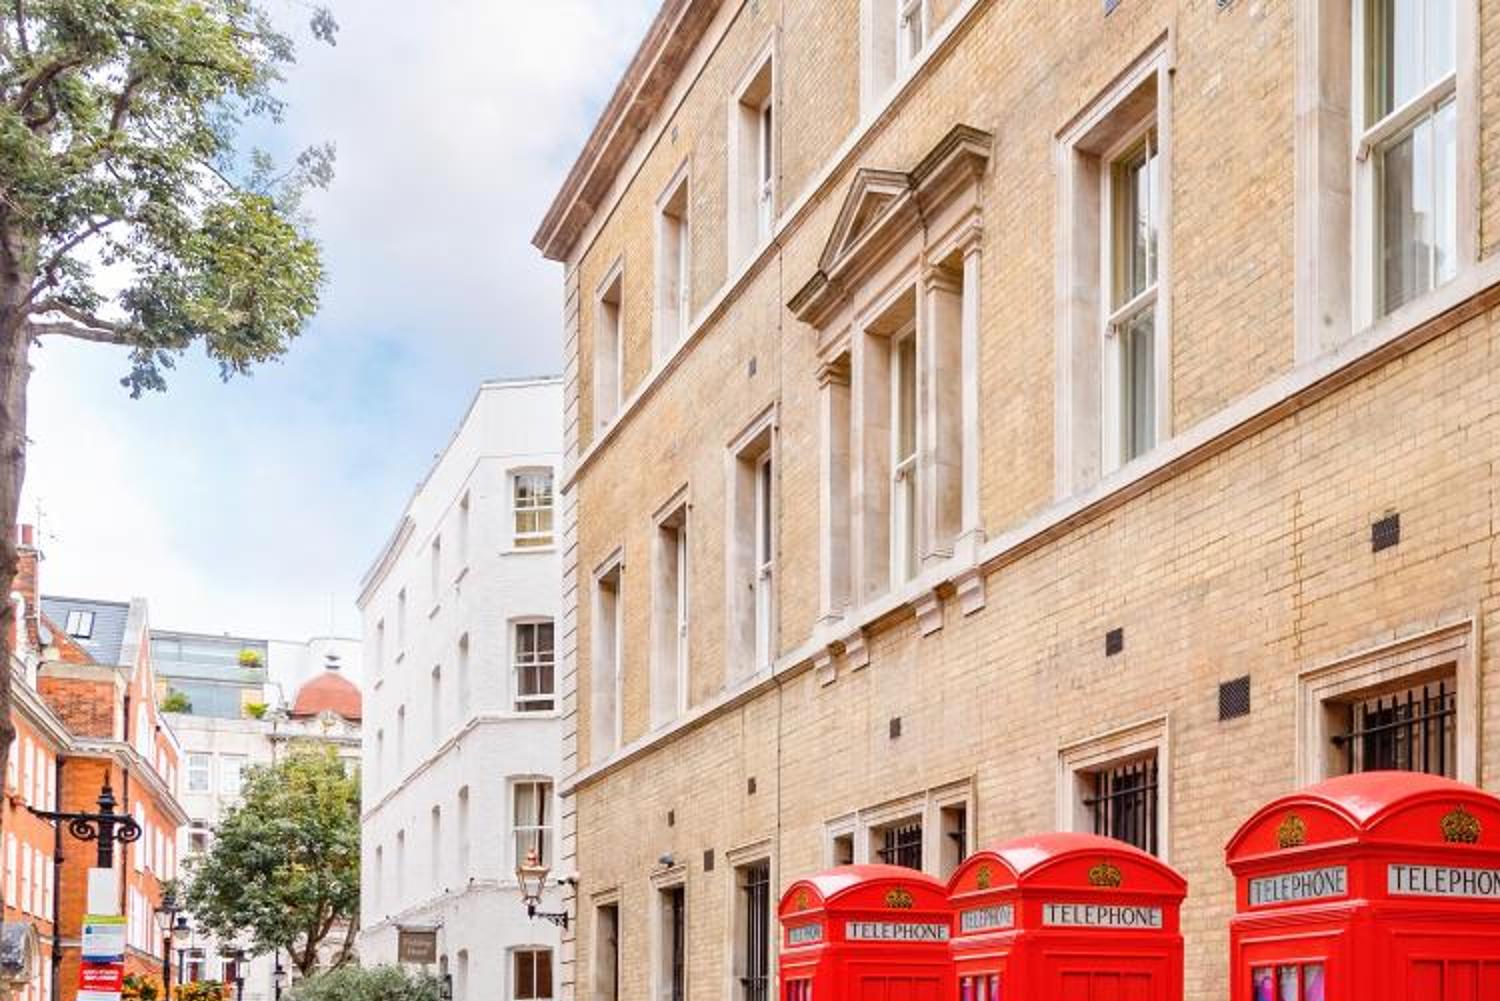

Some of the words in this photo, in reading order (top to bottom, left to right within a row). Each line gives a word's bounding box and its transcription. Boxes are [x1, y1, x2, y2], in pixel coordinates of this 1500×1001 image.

[1253, 868, 1345, 904] TELEPHONE
[1050, 904, 1159, 926] TELEPHONE
[851, 922, 946, 939] TELEPHONE
